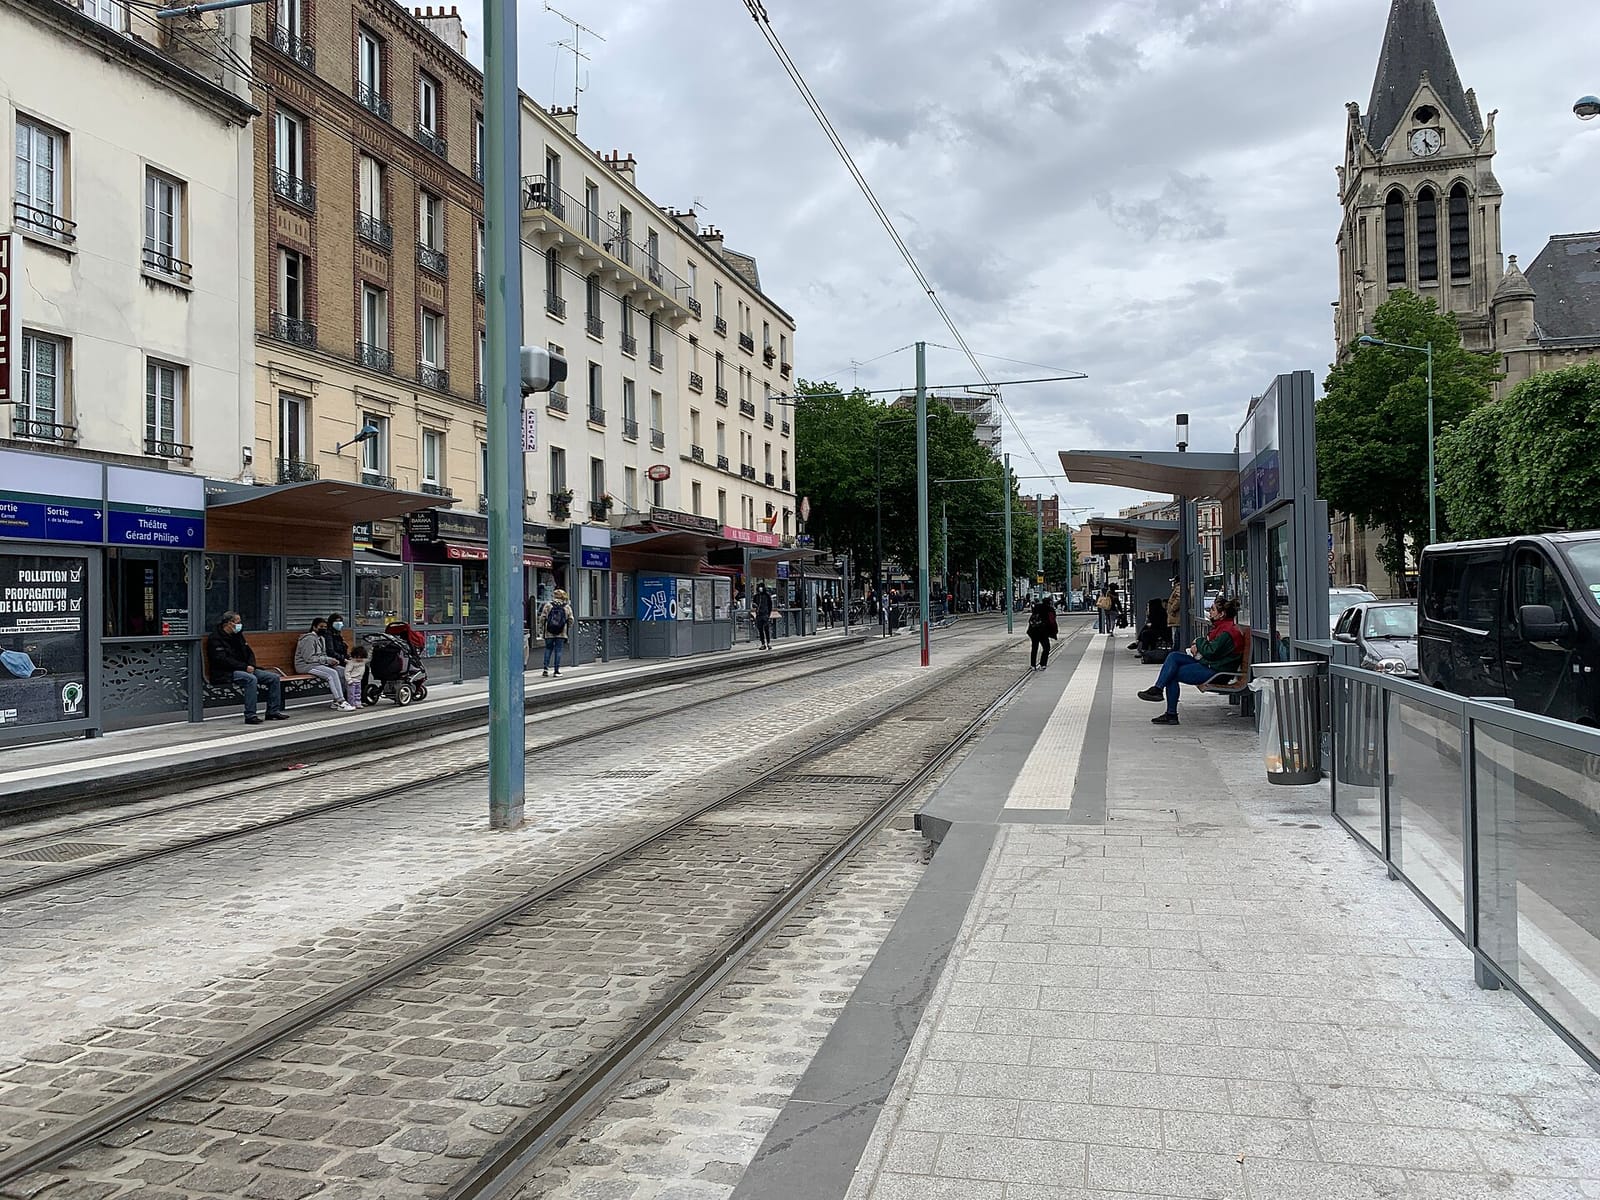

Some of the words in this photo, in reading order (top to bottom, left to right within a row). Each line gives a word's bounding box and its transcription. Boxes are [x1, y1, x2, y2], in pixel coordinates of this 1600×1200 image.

[0, 503, 18, 513] ortie
[47, 506, 70, 517] Sortie
[138, 518, 168, 530] Théâtre
[125, 530, 152, 541] Gérard
[153, 532, 179, 544] Philipe
[18, 570, 67, 582] POLLUTION
[5, 588, 67, 600] PROPAGATION
[0, 601, 11, 613] DE
[12, 601, 24, 613] LA
[25, 600, 67, 612] COVID-19
